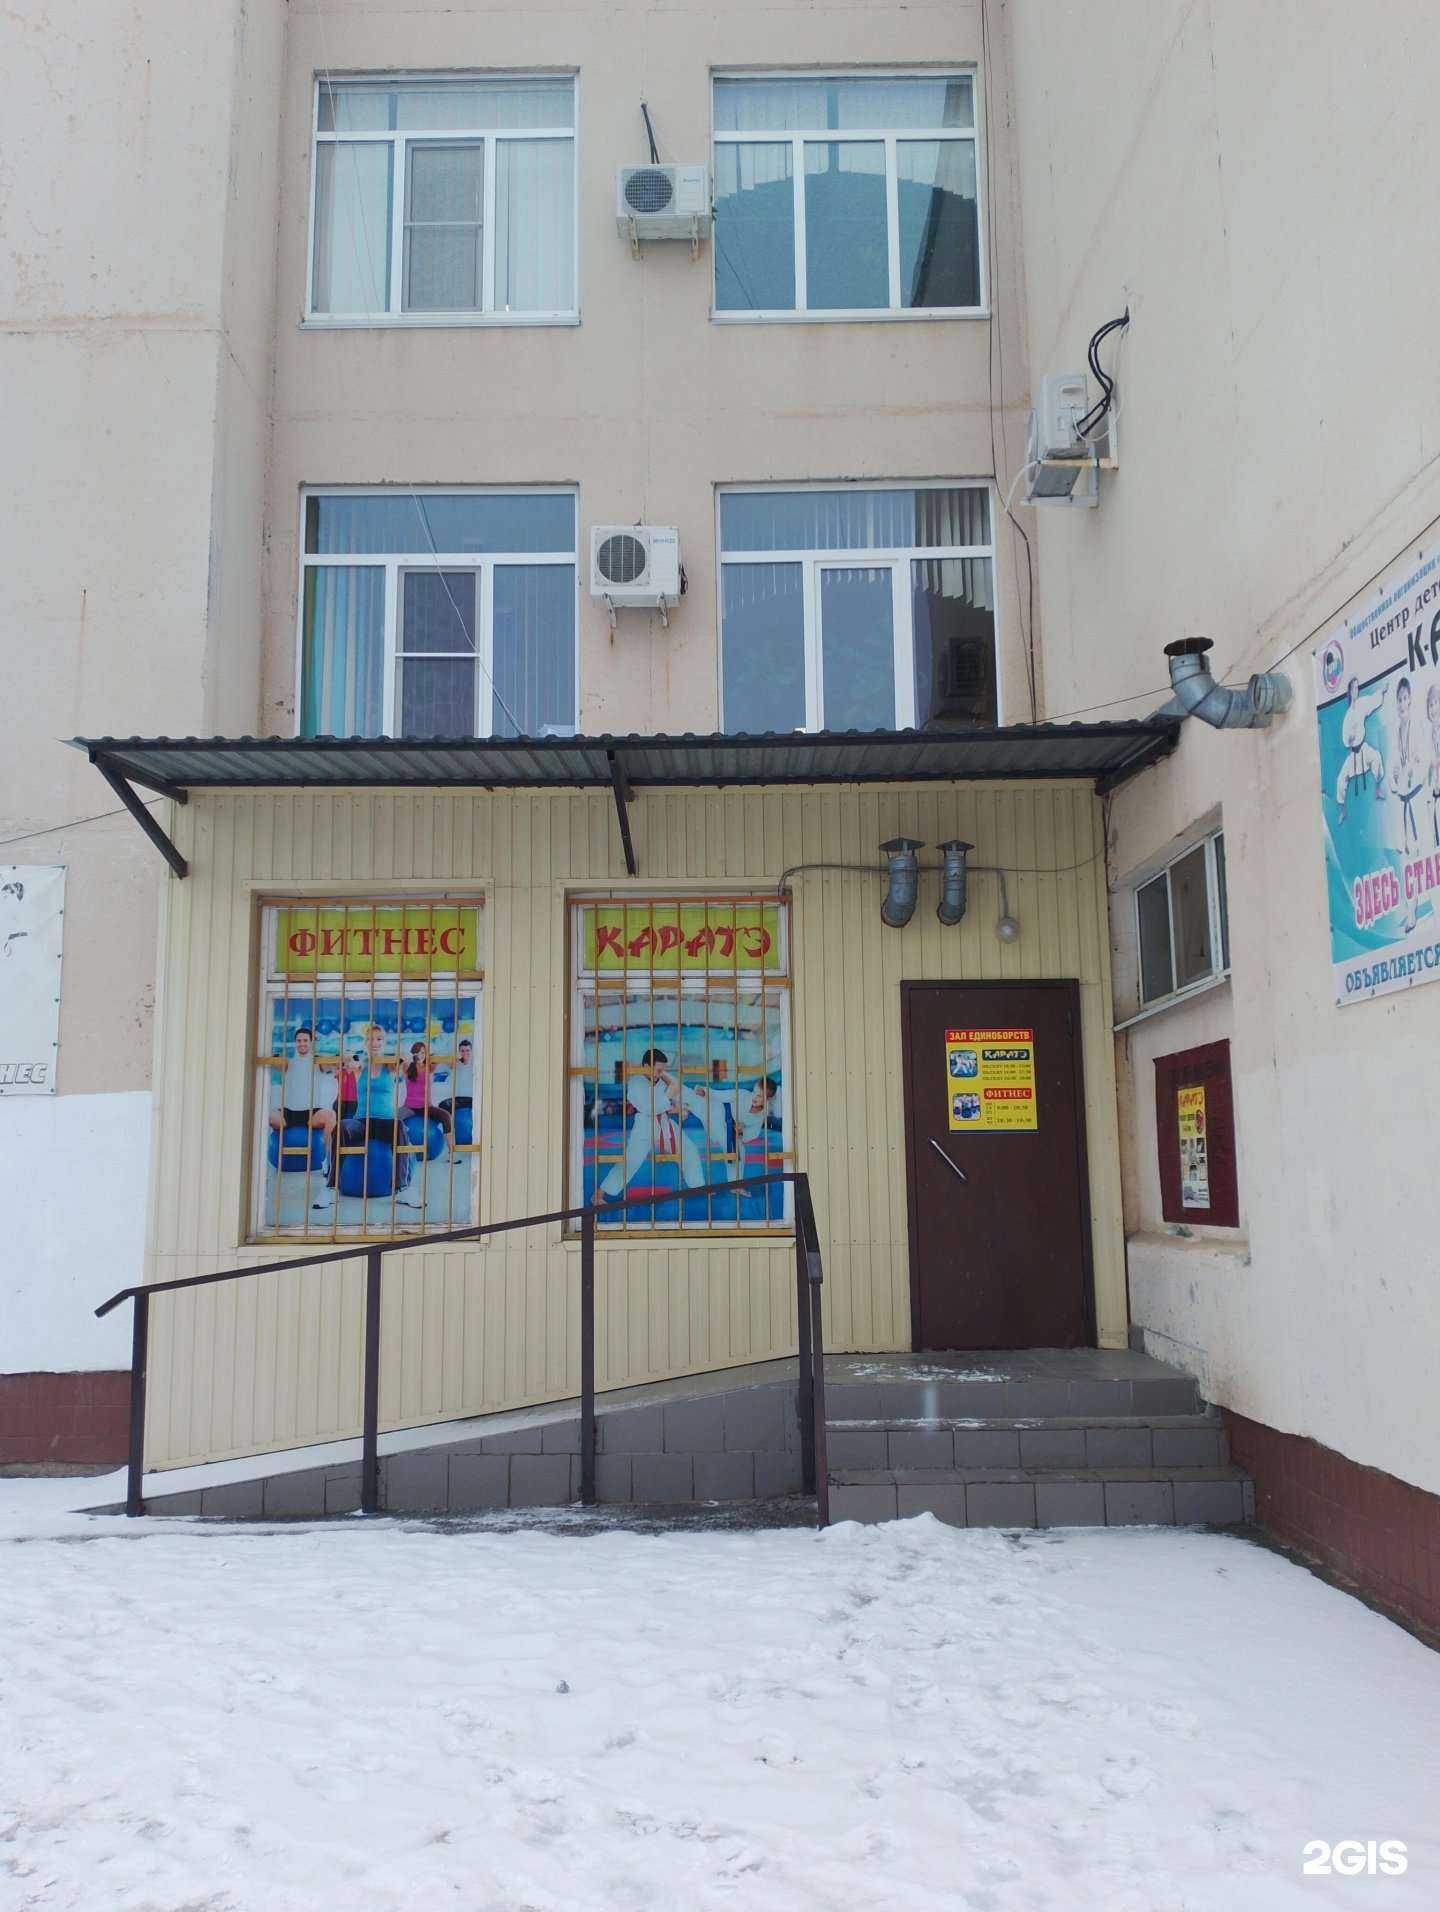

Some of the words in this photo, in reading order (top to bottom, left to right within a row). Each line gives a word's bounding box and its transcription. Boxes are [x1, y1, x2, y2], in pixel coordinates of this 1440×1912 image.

[1370, 606, 1410, 649] Центр
[1355, 871, 1400, 925] ЗДЕСЬ
[289, 927, 466, 957] ФИТНЕС
[595, 925, 771, 958] КАРАТЭ
[949, 1031, 967, 1041] ЗАЛ
[969, 1031, 1030, 1041] ЕДИНОБОРСТВ
[984, 1050, 1027, 1059] КАРАТЭ
[985, 1089, 1031, 1098] ФИТНЕС
